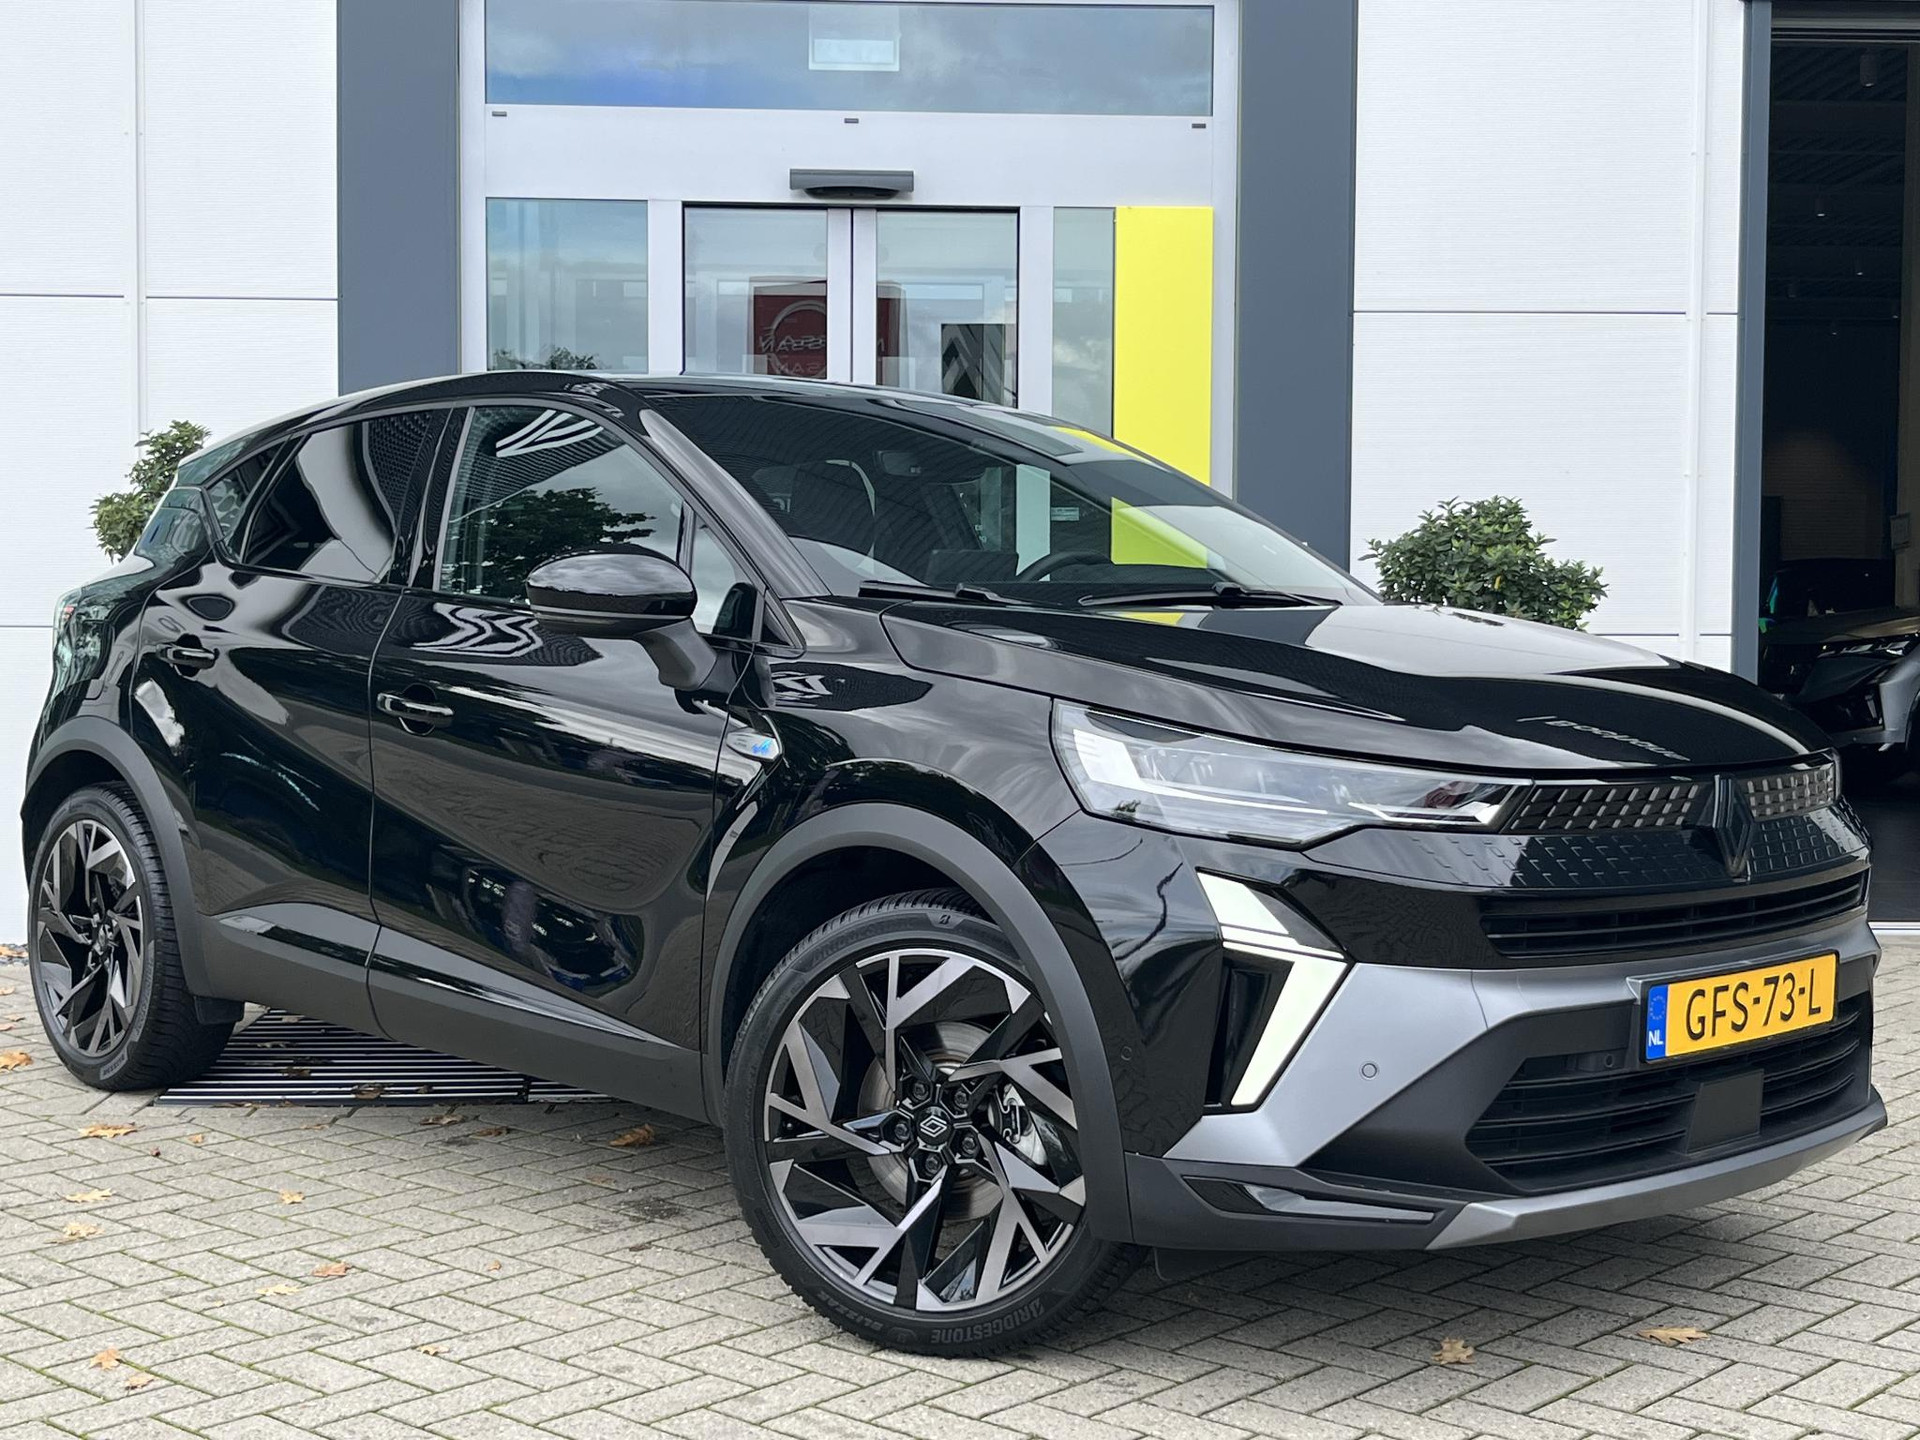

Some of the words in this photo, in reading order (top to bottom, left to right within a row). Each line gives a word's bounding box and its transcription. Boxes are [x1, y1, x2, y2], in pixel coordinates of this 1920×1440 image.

[1685, 967, 1822, 1041] GFS-73-L
[1648, 1030, 1664, 1047] NL
[930, 1298, 1045, 1344] BRIDGESTONE
